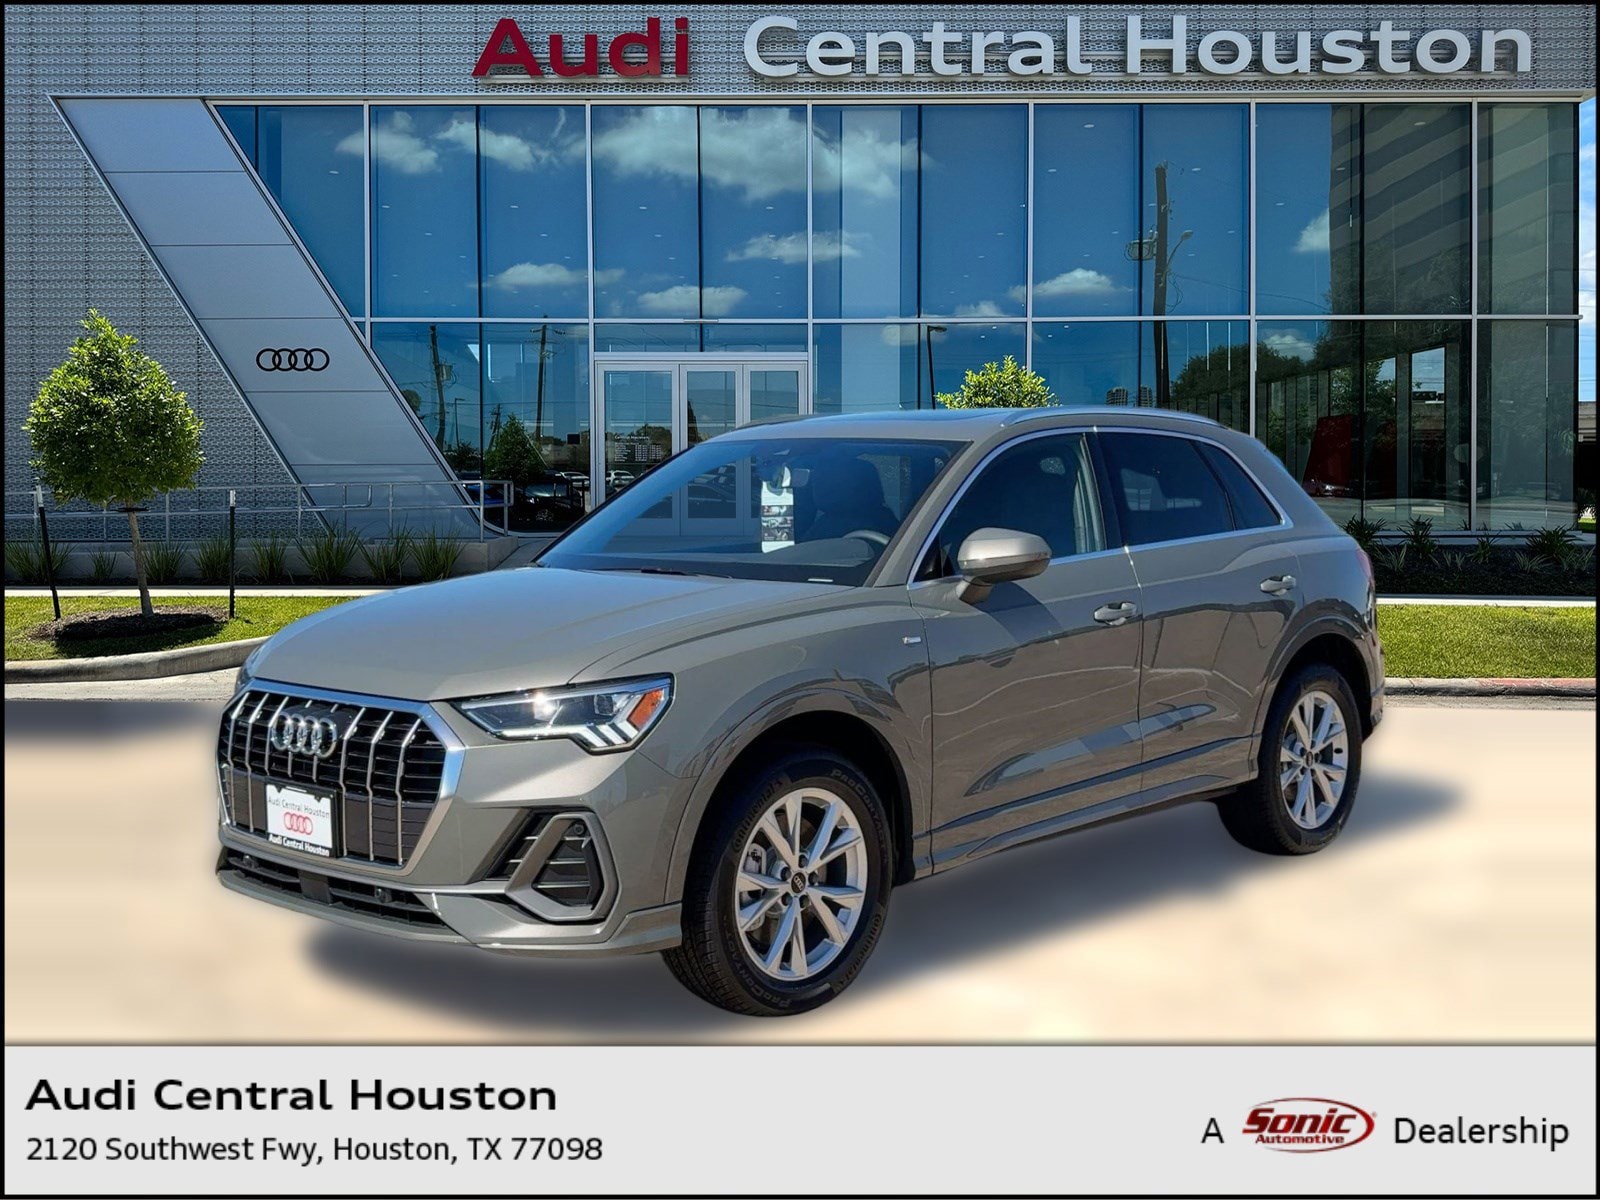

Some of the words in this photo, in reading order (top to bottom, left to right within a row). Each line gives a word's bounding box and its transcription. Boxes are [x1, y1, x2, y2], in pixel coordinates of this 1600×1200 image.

[471, 16, 689, 78] Audi
[743, 15, 1092, 77] Central
[1126, 14, 1532, 75] Houston
[268, 796, 281, 807] Audi
[282, 799, 302, 812] Central
[304, 804, 330, 818] Houston
[268, 833, 283, 845] Audi
[283, 837, 304, 851] Central
[304, 842, 330, 857] Houston
